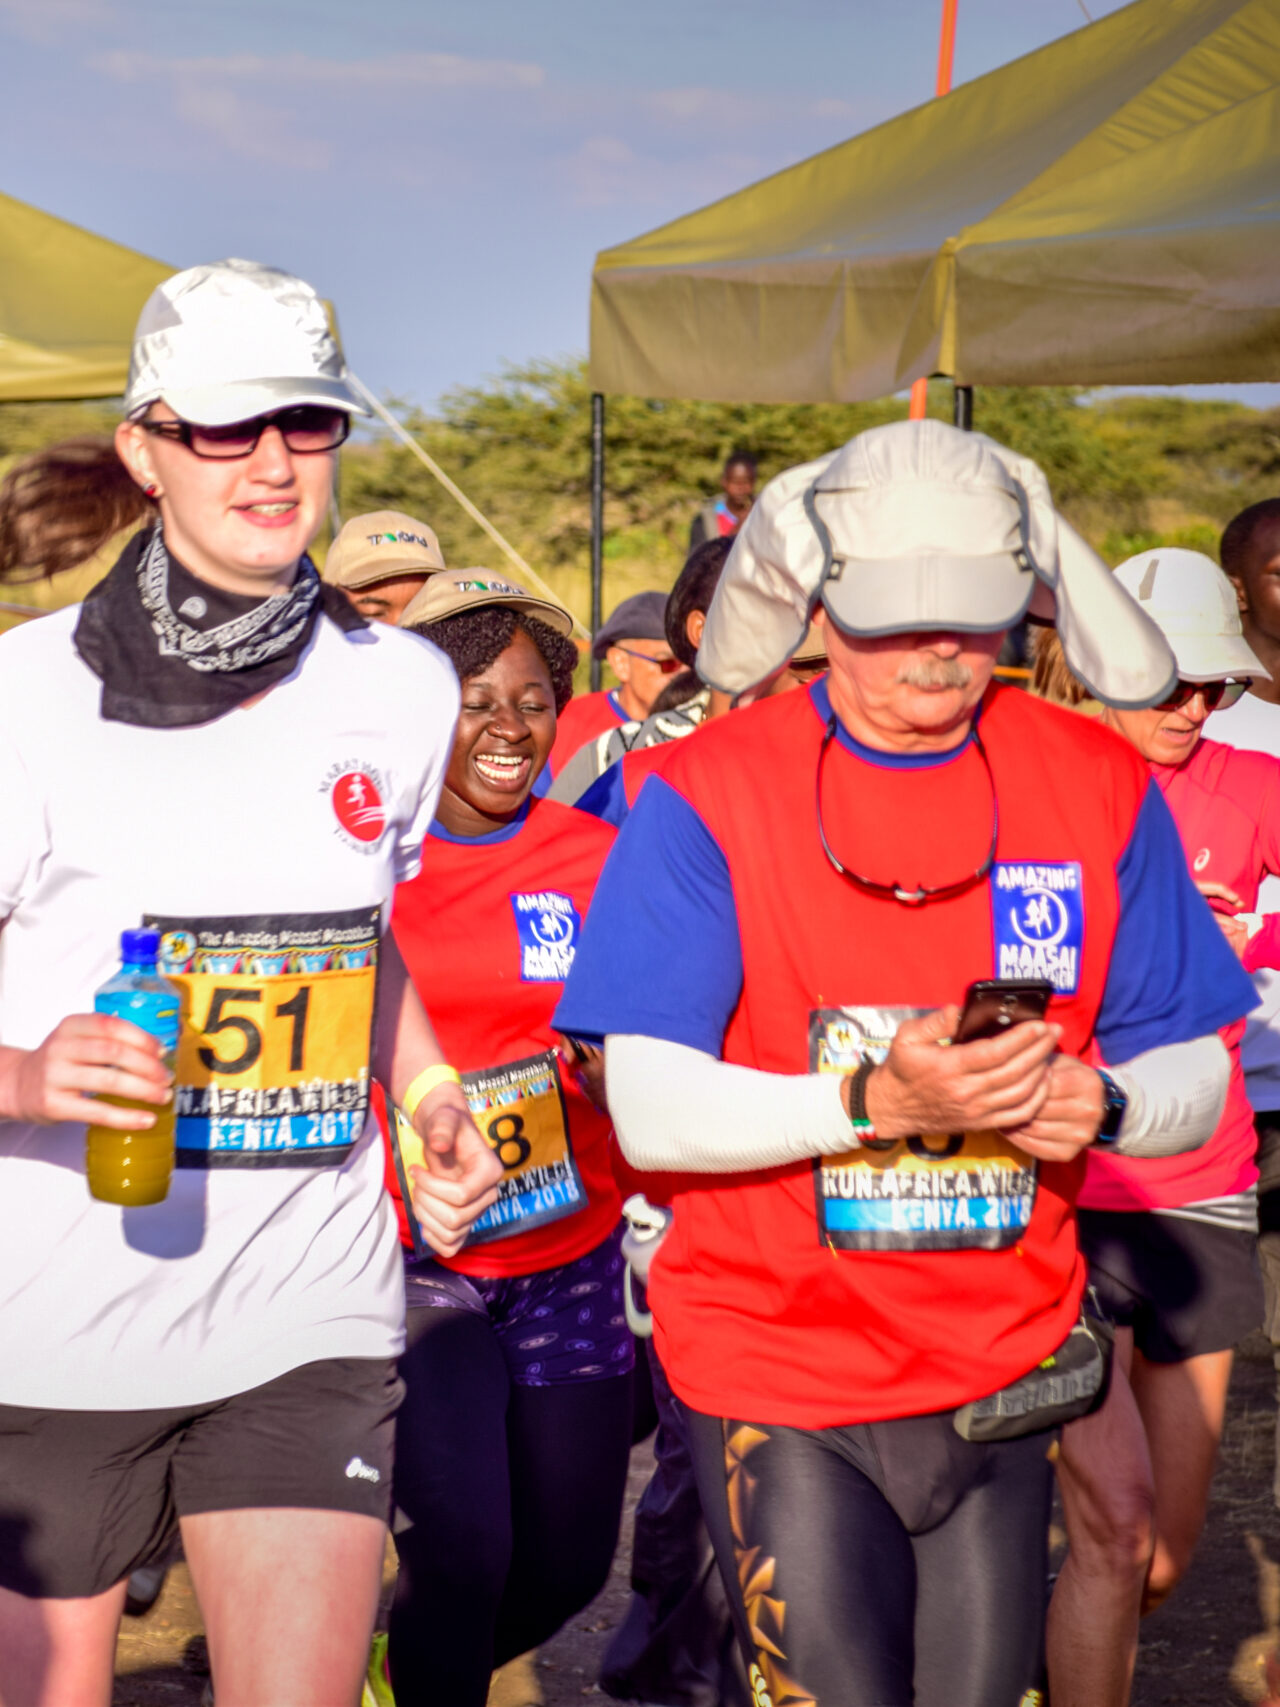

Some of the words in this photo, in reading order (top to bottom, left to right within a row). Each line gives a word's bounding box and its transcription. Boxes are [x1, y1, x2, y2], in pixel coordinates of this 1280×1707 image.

[997, 865, 1077, 891] AMAZING
[1000, 943, 1077, 974] MAASAI
[198, 986, 313, 1075] 51
[477, 1072, 510, 1093] Maasai
[509, 1062, 549, 1084] Marathon
[306, 1110, 366, 1144] 2018
[531, 1178, 580, 1212] 2018
[983, 1195, 1033, 1229] 2018
